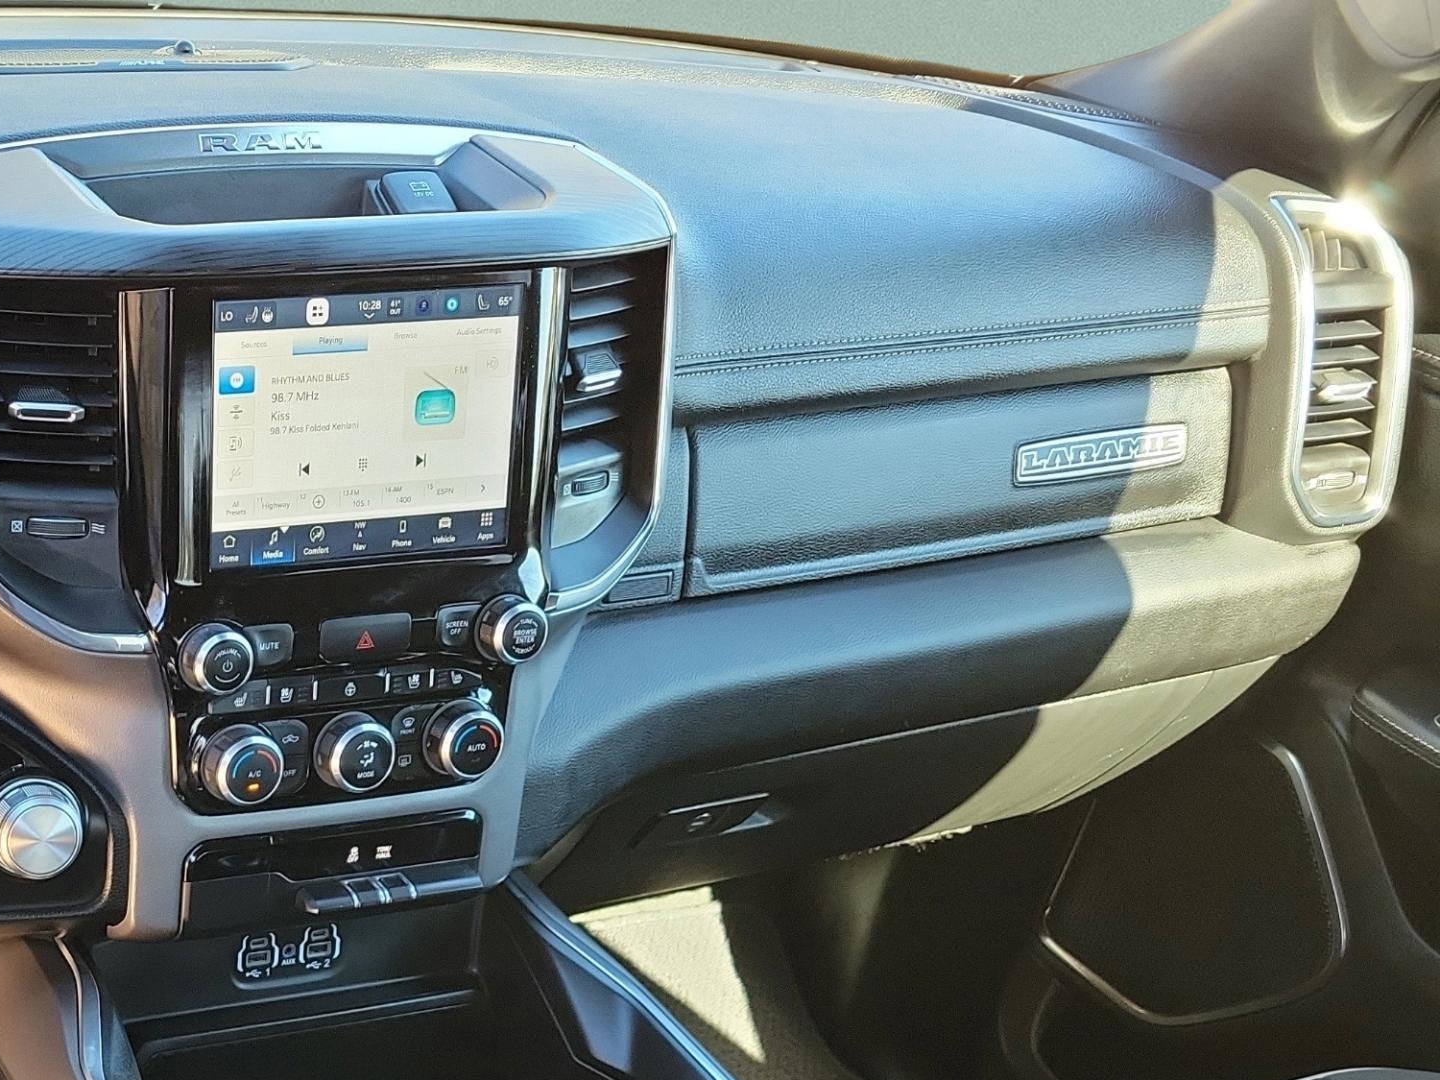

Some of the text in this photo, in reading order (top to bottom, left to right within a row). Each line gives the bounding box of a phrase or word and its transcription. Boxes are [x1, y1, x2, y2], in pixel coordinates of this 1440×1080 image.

[198, 130, 322, 152] RAM
[358, 300, 381, 311] 10:28
[220, 311, 233, 322] LO
[319, 337, 343, 346] Playing
[272, 372, 350, 385] RHYTHM AND BLUES
[271, 391, 320, 403] 98.7 MHz
[271, 411, 290, 421] Kiss
[288, 425, 305, 434] Kiss
[306, 424, 330, 432] Folded
[1023, 434, 1180, 472] LARAMIE
[432, 535, 456, 544] Vehicle
[477, 532, 494, 541] Apps
[352, 543, 367, 551] Nav
[392, 539, 412, 548] Phone
[263, 550, 283, 559] Media
[303, 546, 329, 555] Comfort
[219, 555, 239, 563] Home
[446, 620, 469, 629] SCREEN
[514, 628, 537, 637] BROWSE
[516, 636, 535, 644] ENTER
[260, 642, 280, 650] MUTE
[217, 648, 239, 657] VOLUME
[467, 743, 486, 752] AUTO
[248, 770, 261, 779] A/C
[283, 769, 297, 778] OFF
[357, 770, 375, 779] MODE
[282, 958, 296, 966] AUX
[324, 959, 331, 968] 2
[265, 967, 270, 976] 1
